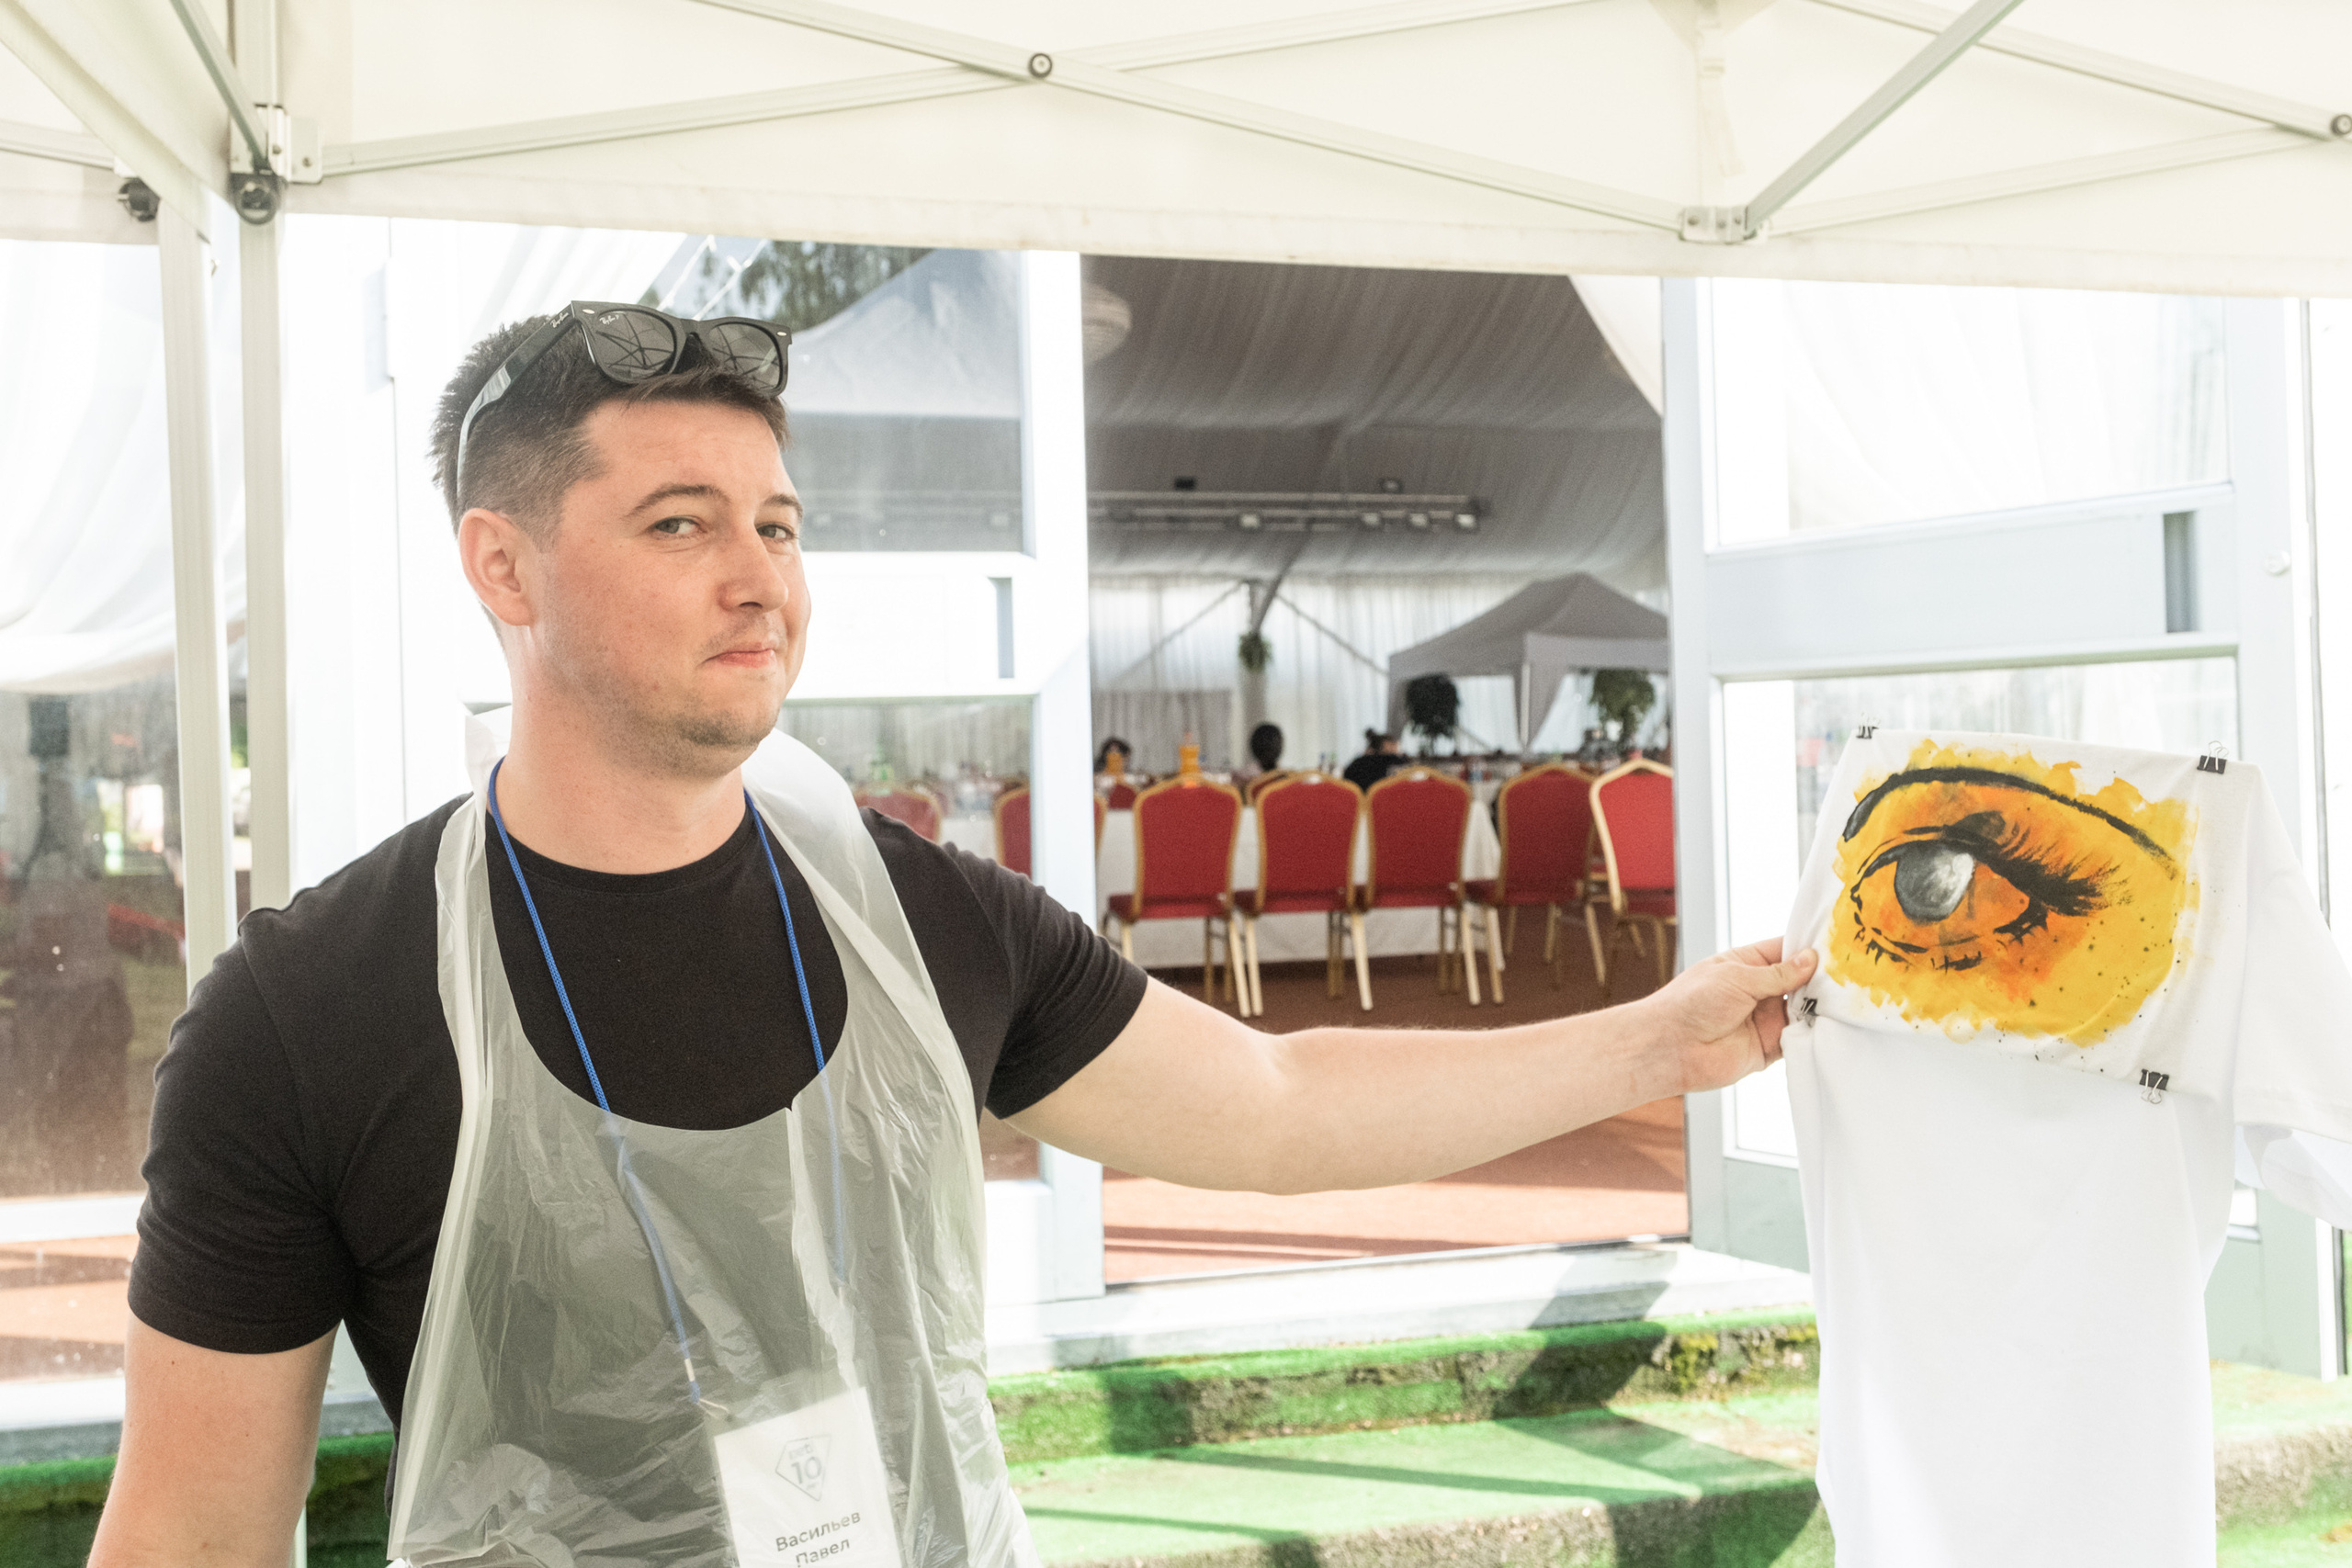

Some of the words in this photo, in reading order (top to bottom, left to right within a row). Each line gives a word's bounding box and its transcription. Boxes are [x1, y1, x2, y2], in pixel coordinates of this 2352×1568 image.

[791, 1456, 822, 1484] 10
[775, 1512, 861, 1552] Васильев
[796, 1539, 850, 1568] Павел
